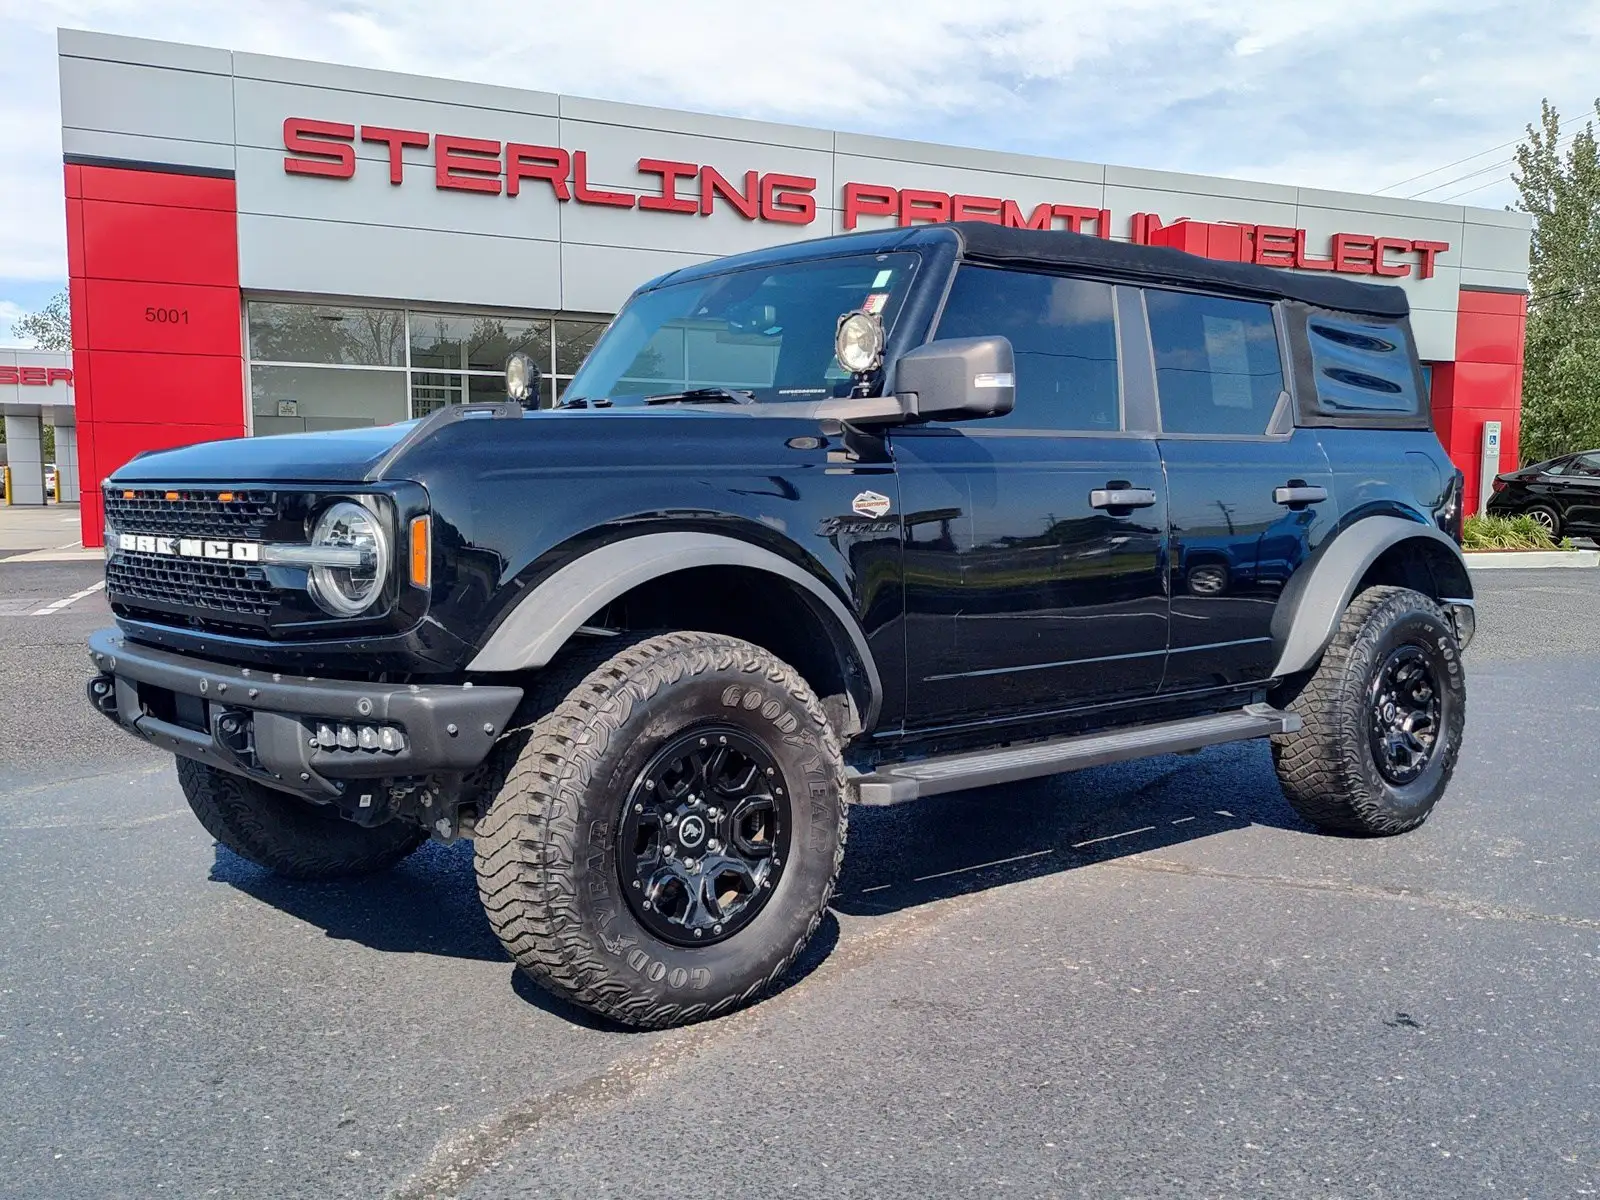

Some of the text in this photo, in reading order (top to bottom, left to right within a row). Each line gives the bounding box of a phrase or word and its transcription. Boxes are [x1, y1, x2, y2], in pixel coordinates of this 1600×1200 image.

[283, 117, 1450, 279] STERLING PREMIU ELECT
[145, 307, 188, 324] 5001
[120, 534, 259, 562] BRONCO
